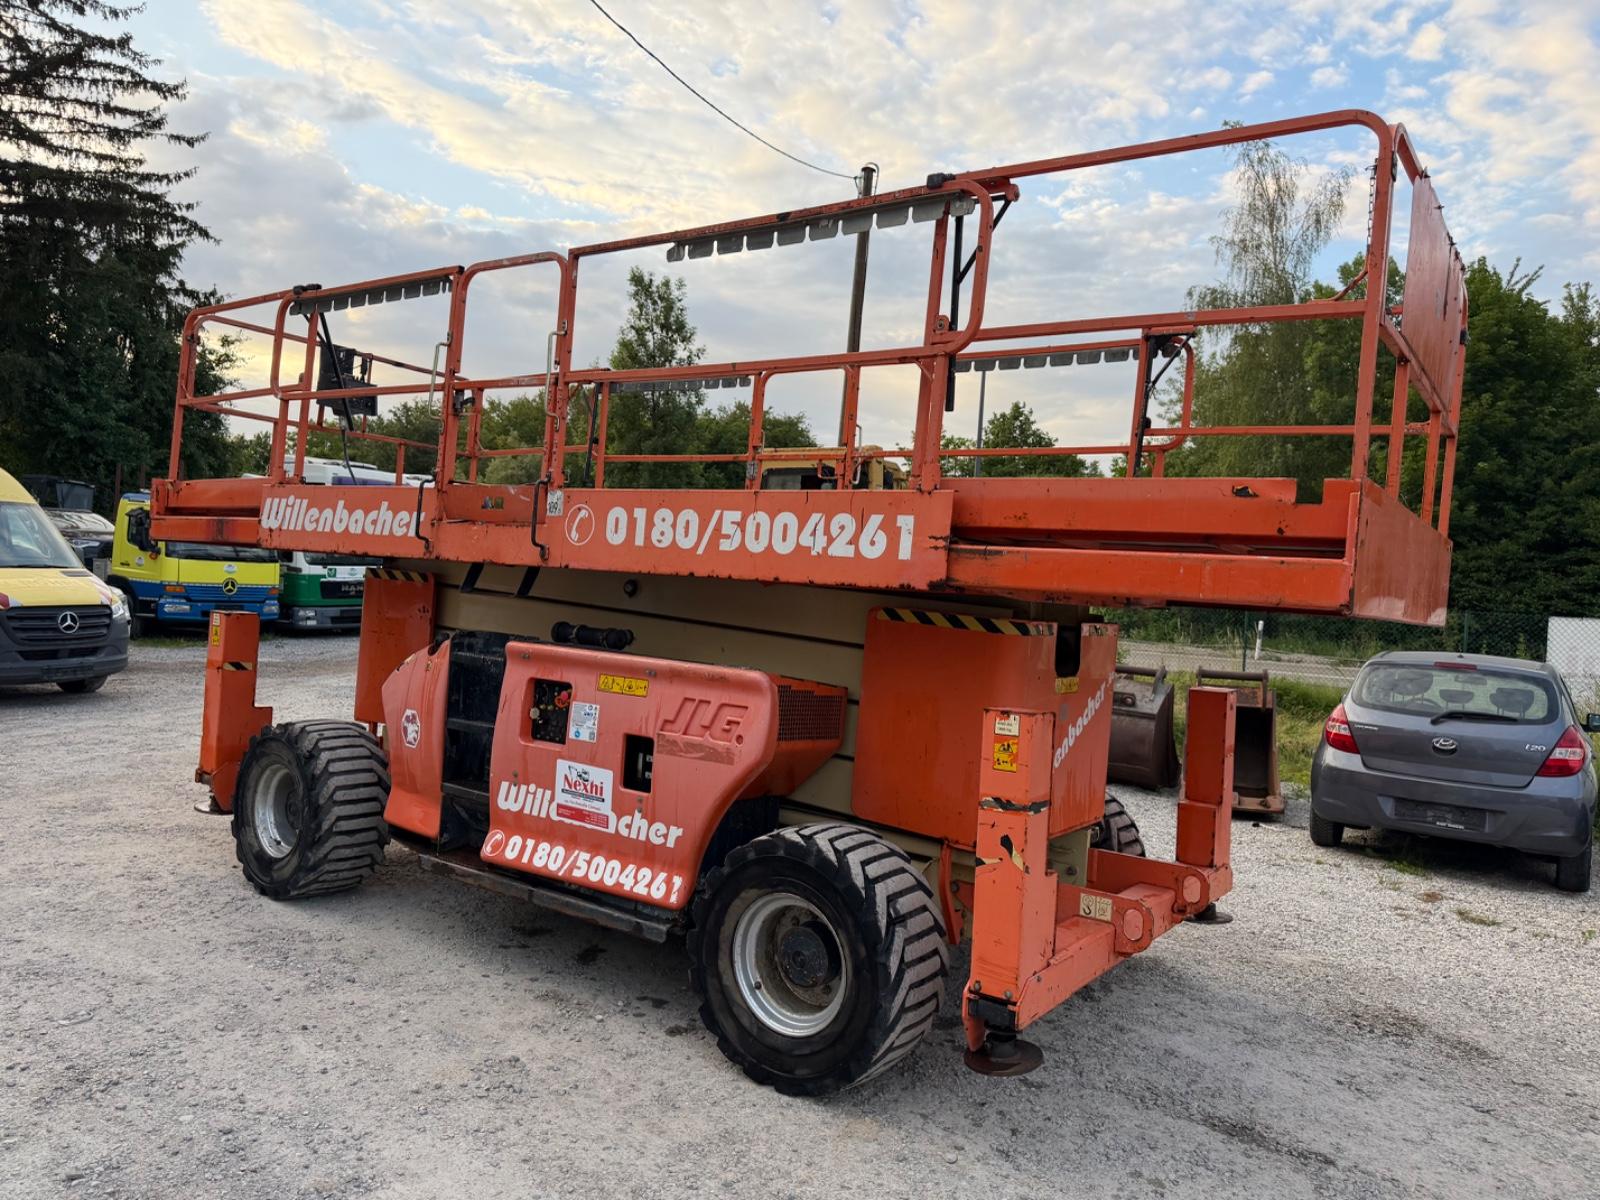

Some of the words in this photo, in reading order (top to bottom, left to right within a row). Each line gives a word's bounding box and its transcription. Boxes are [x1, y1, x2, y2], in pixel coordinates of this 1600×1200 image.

[261, 495, 426, 538] Willenbacher
[605, 506, 915, 561] 0180/5004261
[1053, 681, 1106, 769] enbacher
[497, 781, 684, 848] Willcher
[562, 773, 604, 798] Nexhi
[504, 835, 683, 904] 0180/5004261
